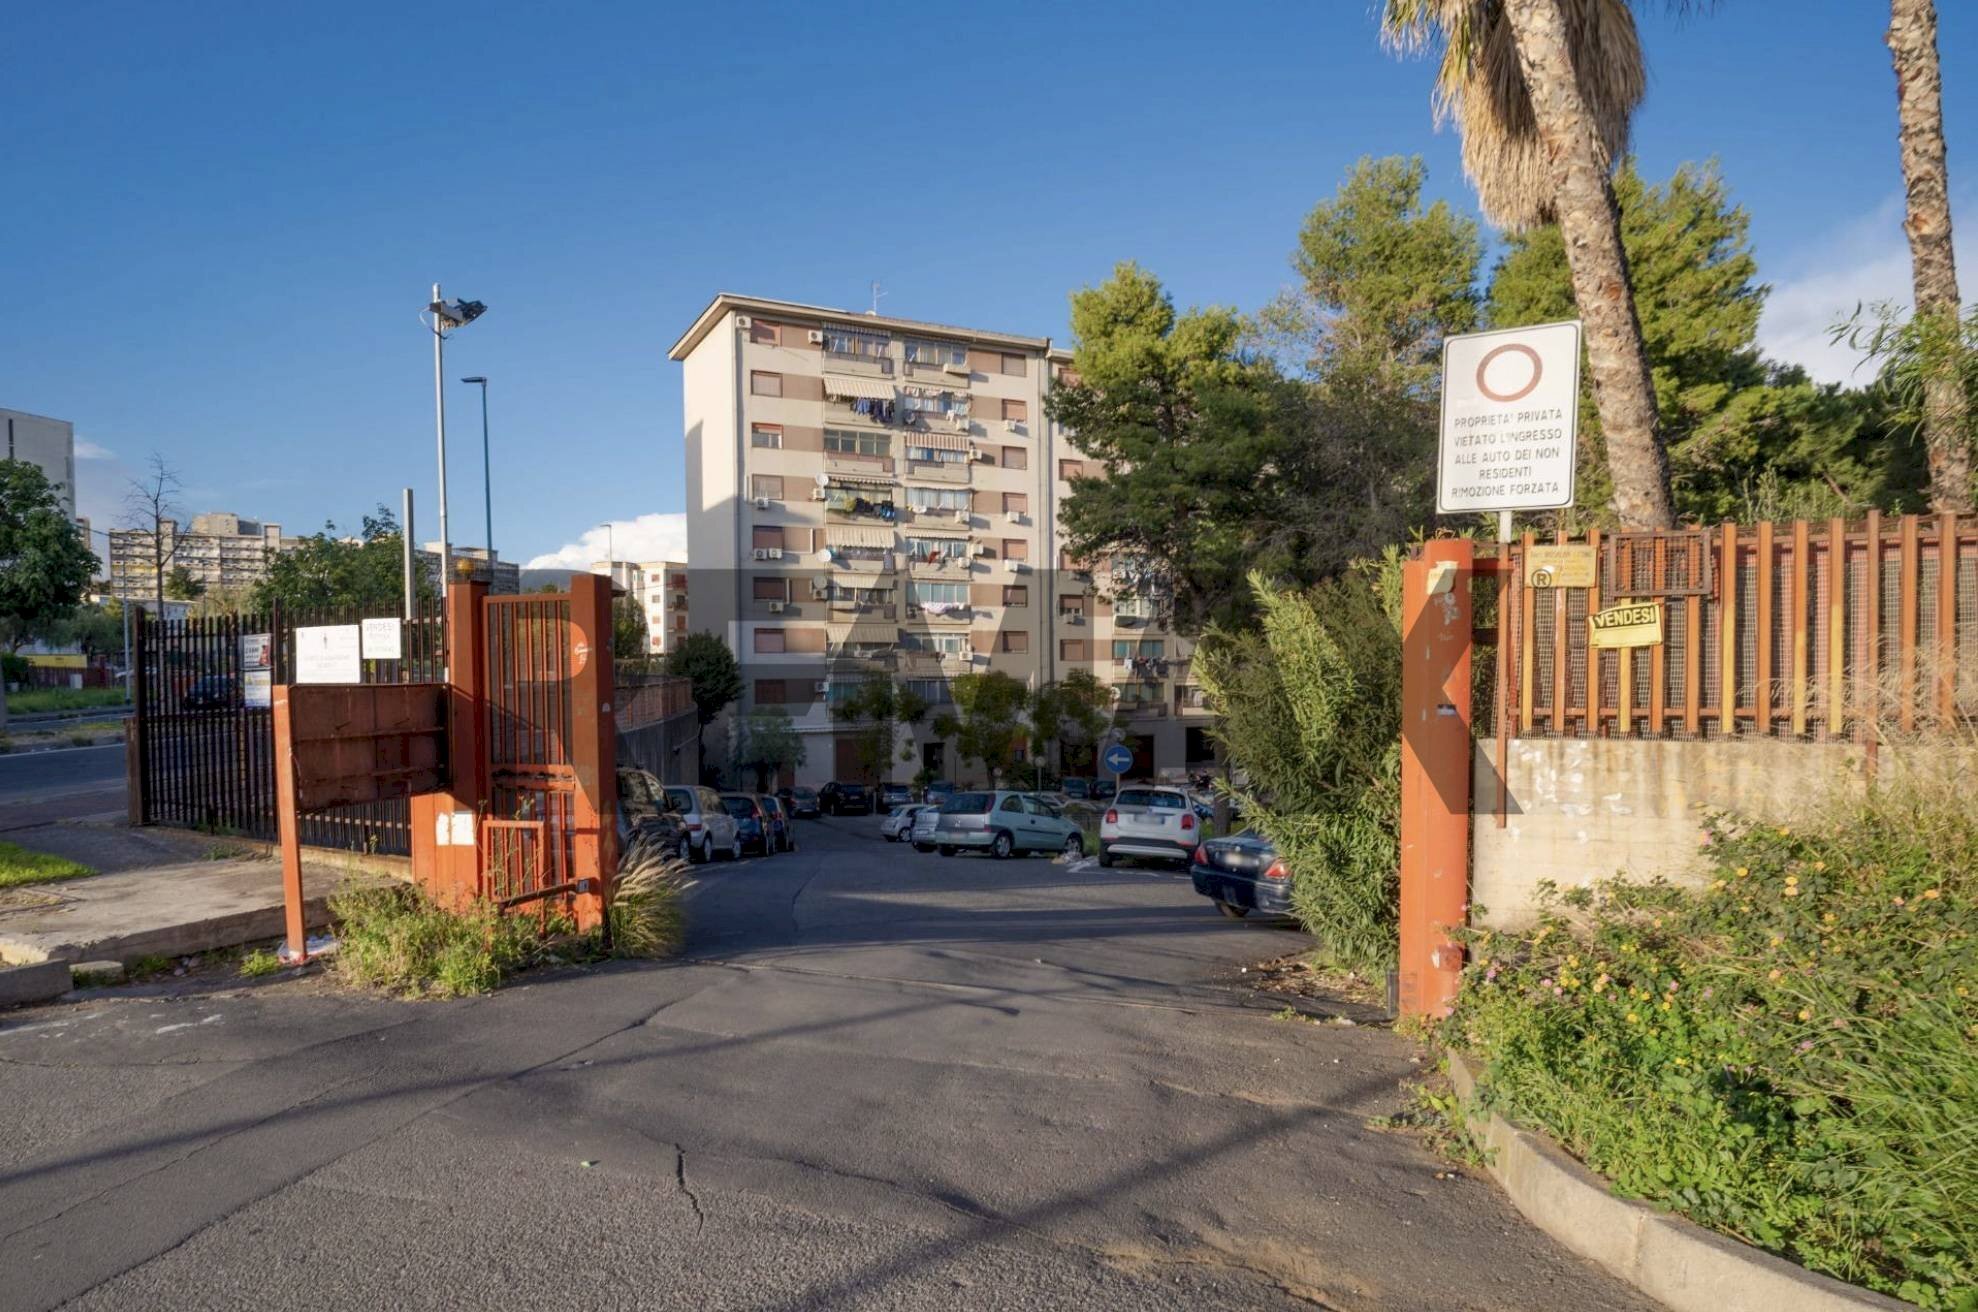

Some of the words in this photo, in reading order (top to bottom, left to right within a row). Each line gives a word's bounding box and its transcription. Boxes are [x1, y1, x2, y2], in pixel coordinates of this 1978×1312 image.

[1517, 408, 1563, 423] PRIVATA
[1454, 433, 1497, 448] VIETATO
[1454, 452, 1477, 464] ALLE
[1481, 450, 1511, 463] AUTO
[1515, 448, 1532, 461] DEI
[1535, 447, 1560, 459] NON
[1479, 466, 1532, 480] RESIDENTI
[1452, 484, 1505, 498] RIMOZIONE
[1509, 481, 1559, 495] FORZATA
[1594, 606, 1656, 628] VENDESI
